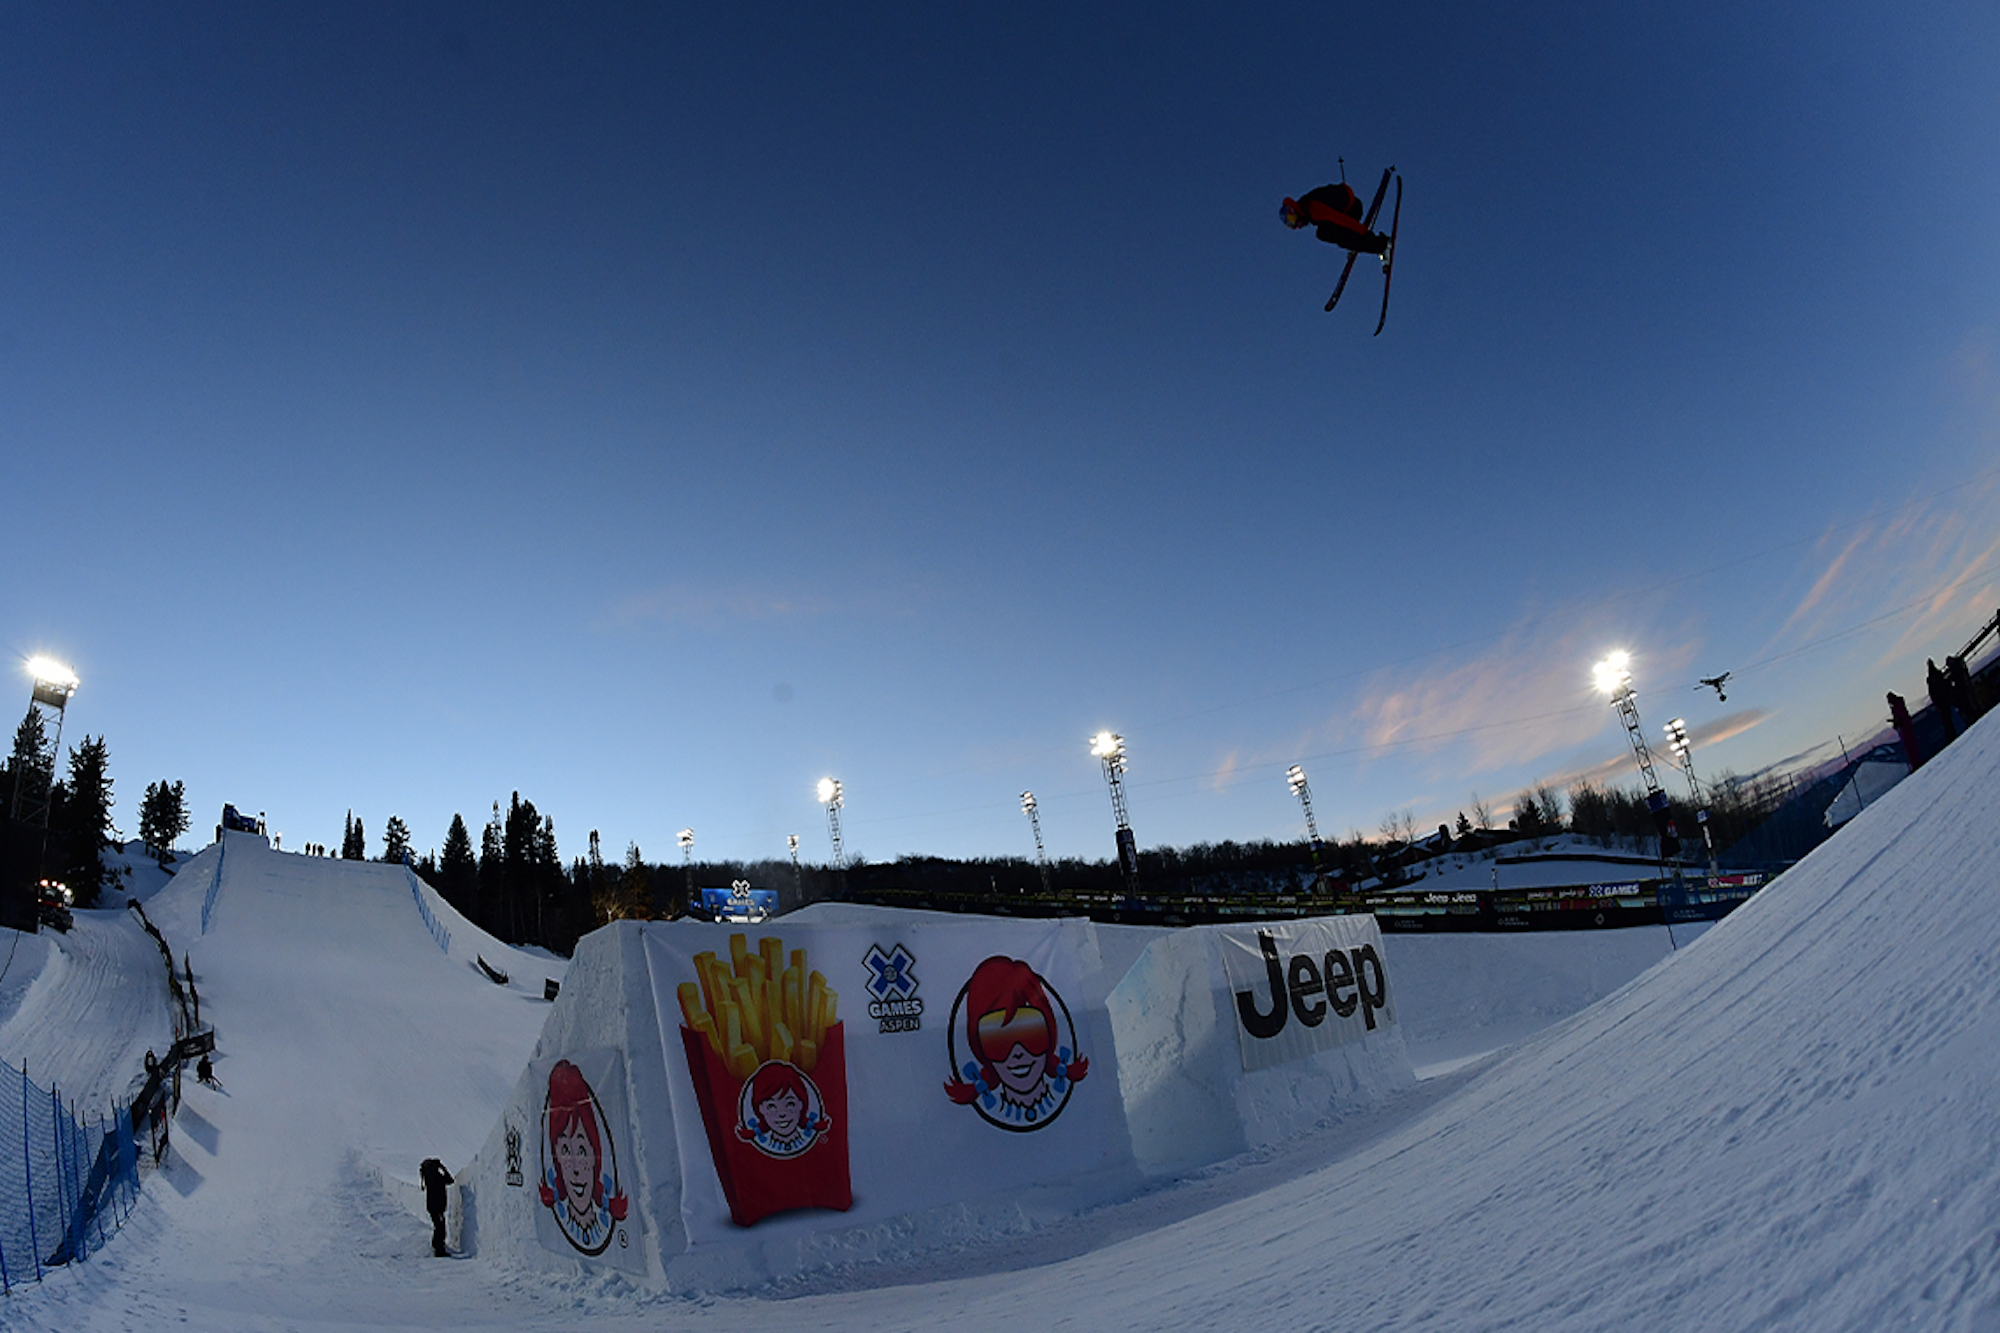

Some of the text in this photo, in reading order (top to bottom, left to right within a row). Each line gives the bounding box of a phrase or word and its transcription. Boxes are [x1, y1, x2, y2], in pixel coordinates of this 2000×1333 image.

[1604, 882, 1640, 896] GAMES
[1235, 928, 1386, 1039] Jeep
[869, 1000, 923, 1018] GAMES
[880, 1018, 920, 1032] ASPEN
